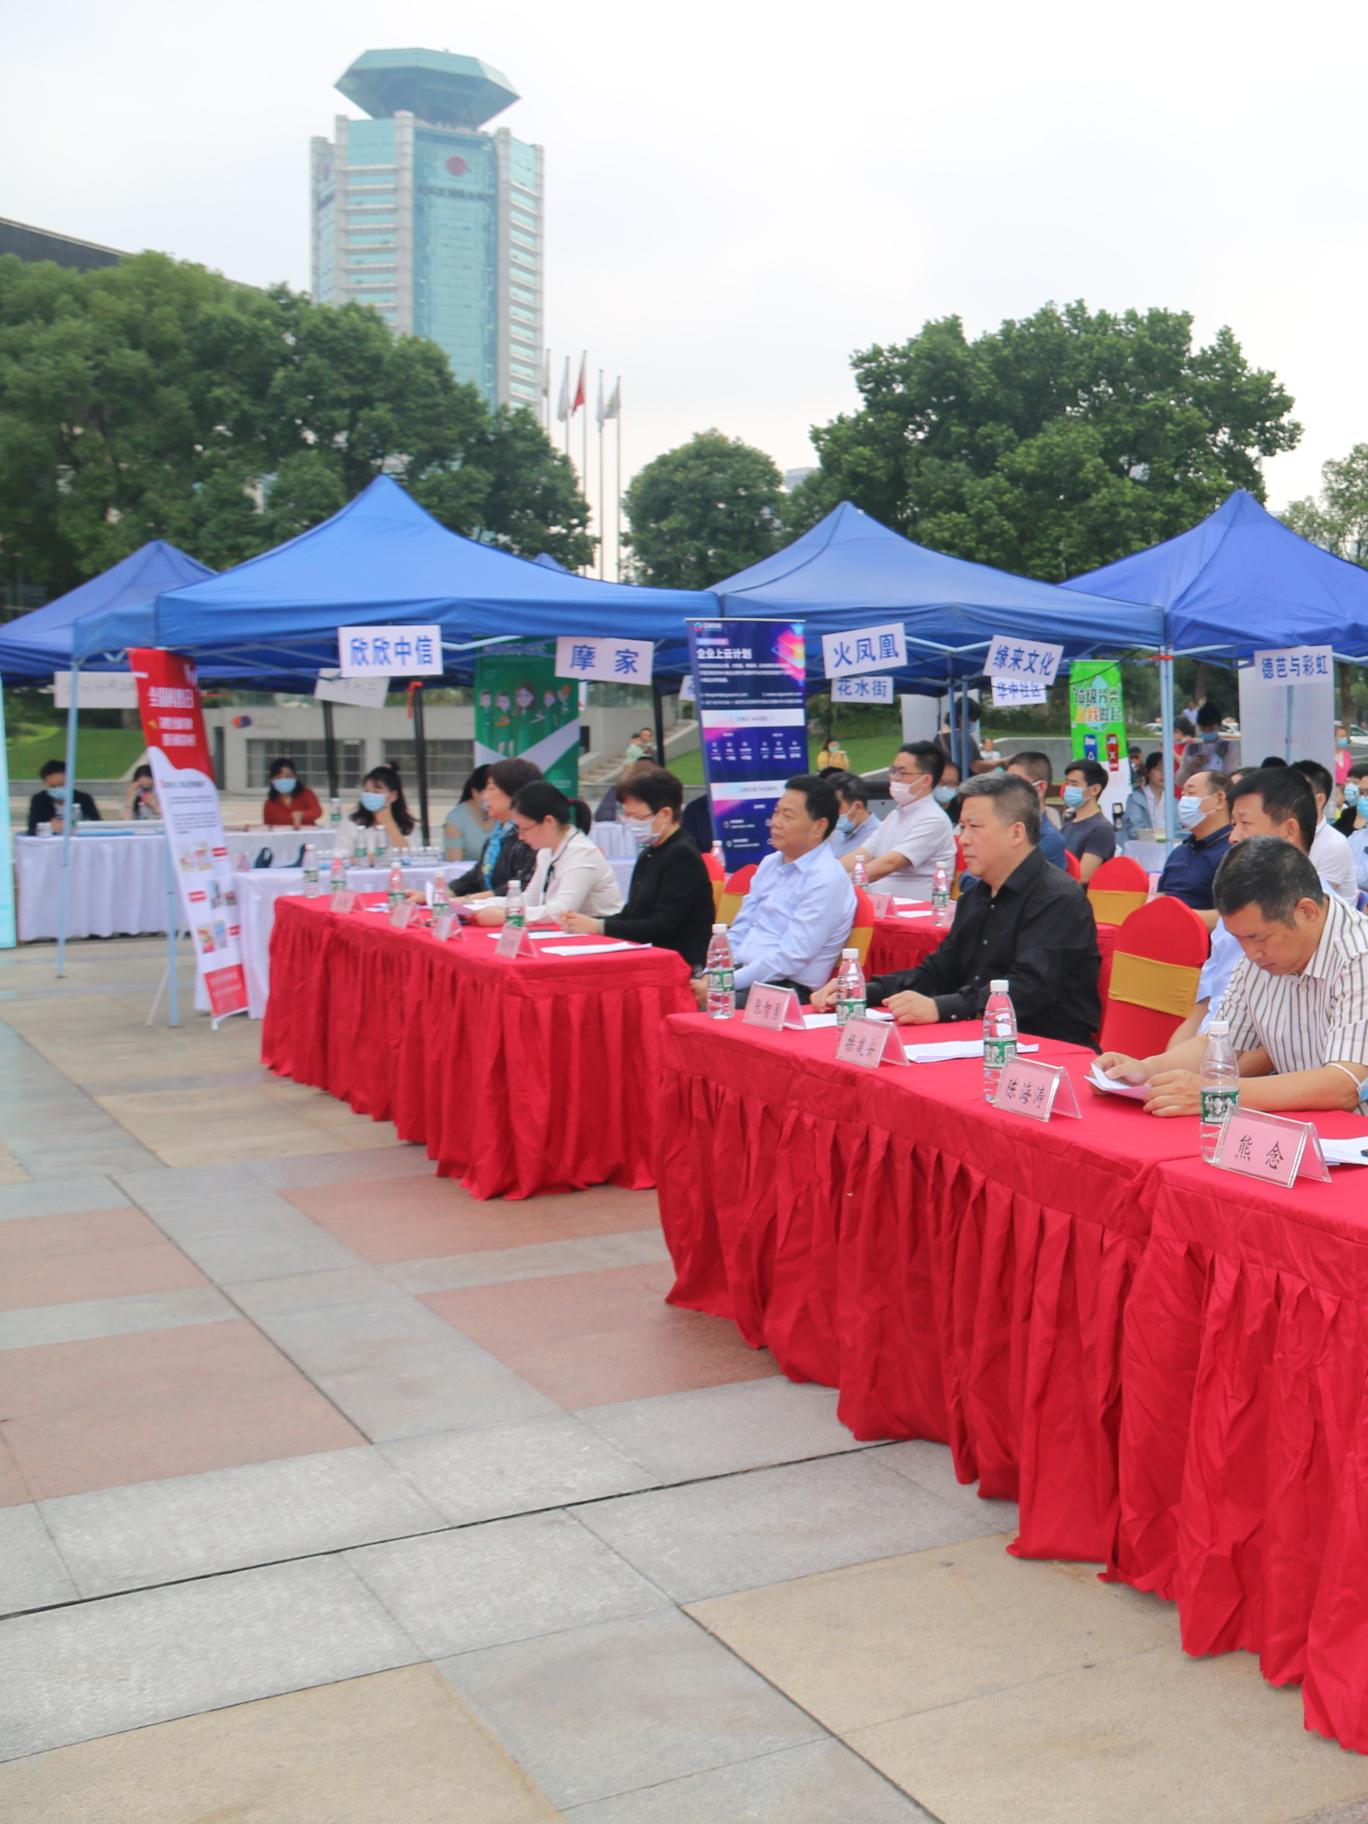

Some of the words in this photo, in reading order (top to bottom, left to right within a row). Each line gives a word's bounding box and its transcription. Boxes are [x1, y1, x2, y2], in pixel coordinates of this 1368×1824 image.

[350, 635, 434, 666] 欣欣中信
[570, 644, 640, 675] 摩家
[832, 633, 899, 668] 火凤凰
[992, 645, 1055, 676] 缘来文化
[1261, 653, 1329, 680] 德芭与彩虹
[837, 678, 888, 698] 花水街
[1234, 1133, 1285, 1170] 熊念
